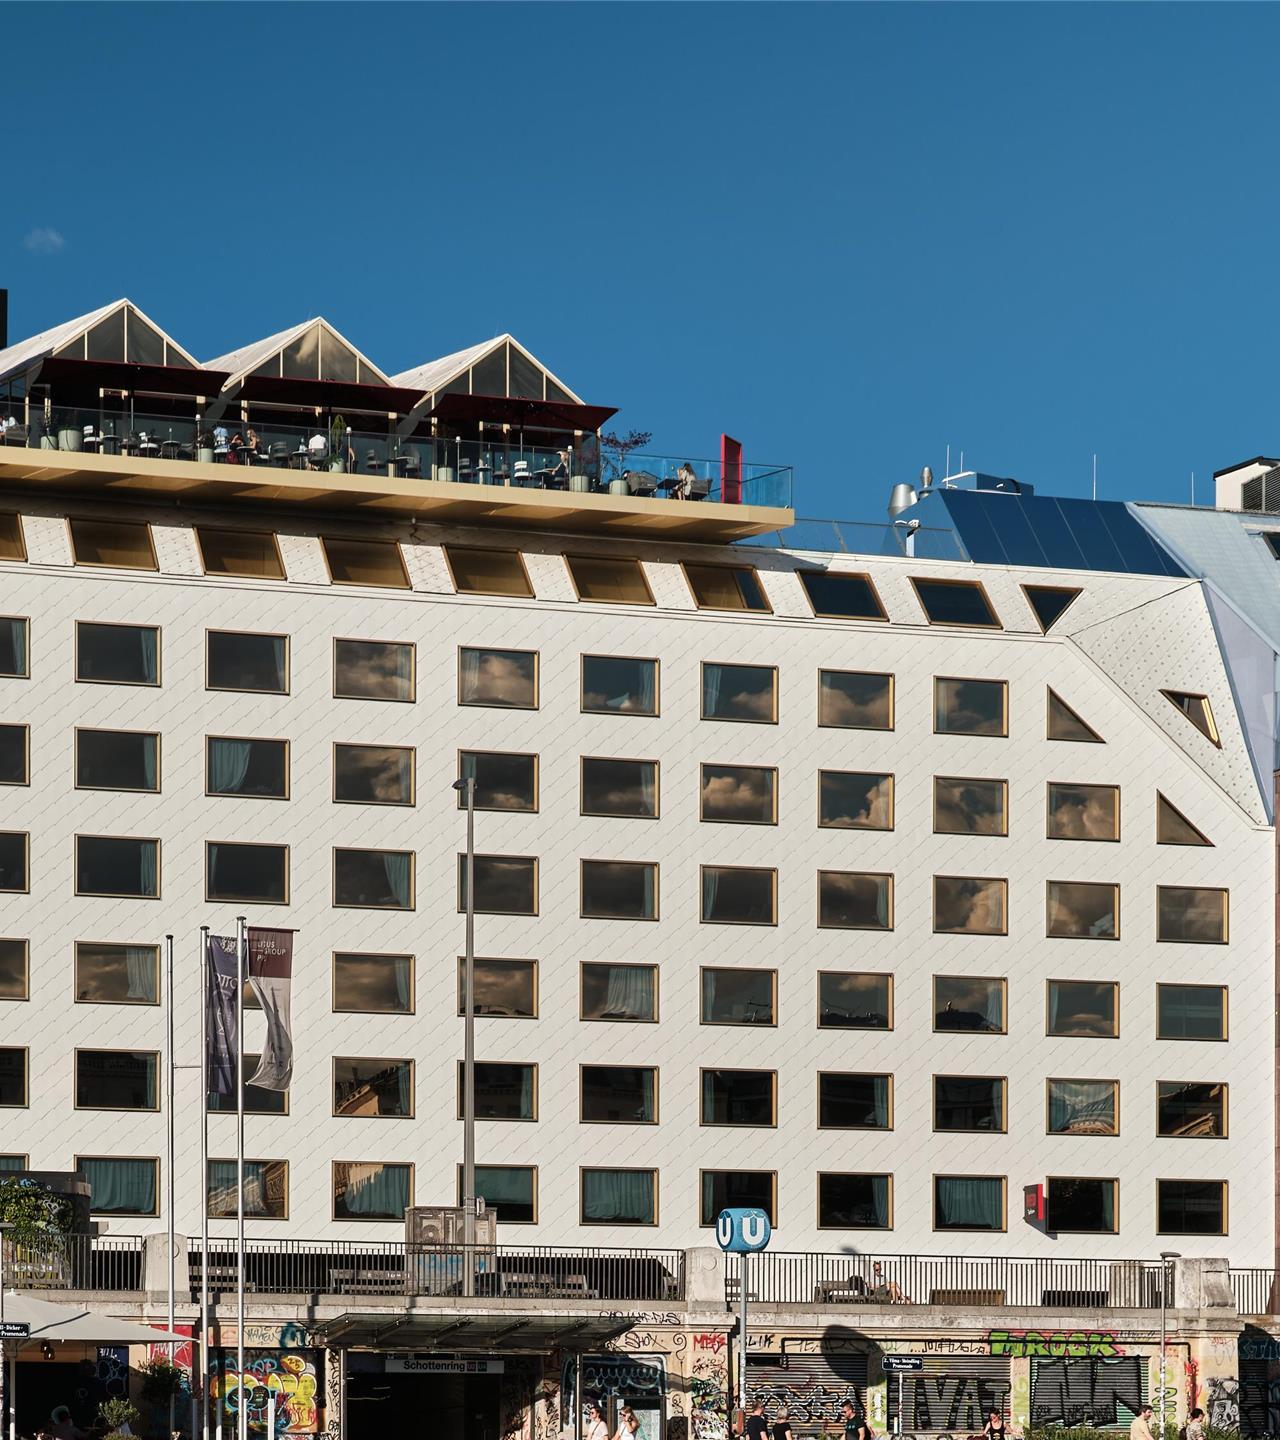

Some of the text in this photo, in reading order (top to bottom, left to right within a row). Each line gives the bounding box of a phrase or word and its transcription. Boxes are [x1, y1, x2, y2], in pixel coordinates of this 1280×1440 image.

[718, 1217, 732, 1247] U
[741, 1215, 766, 1247] U
[403, 1360, 466, 1372] Schottenring
